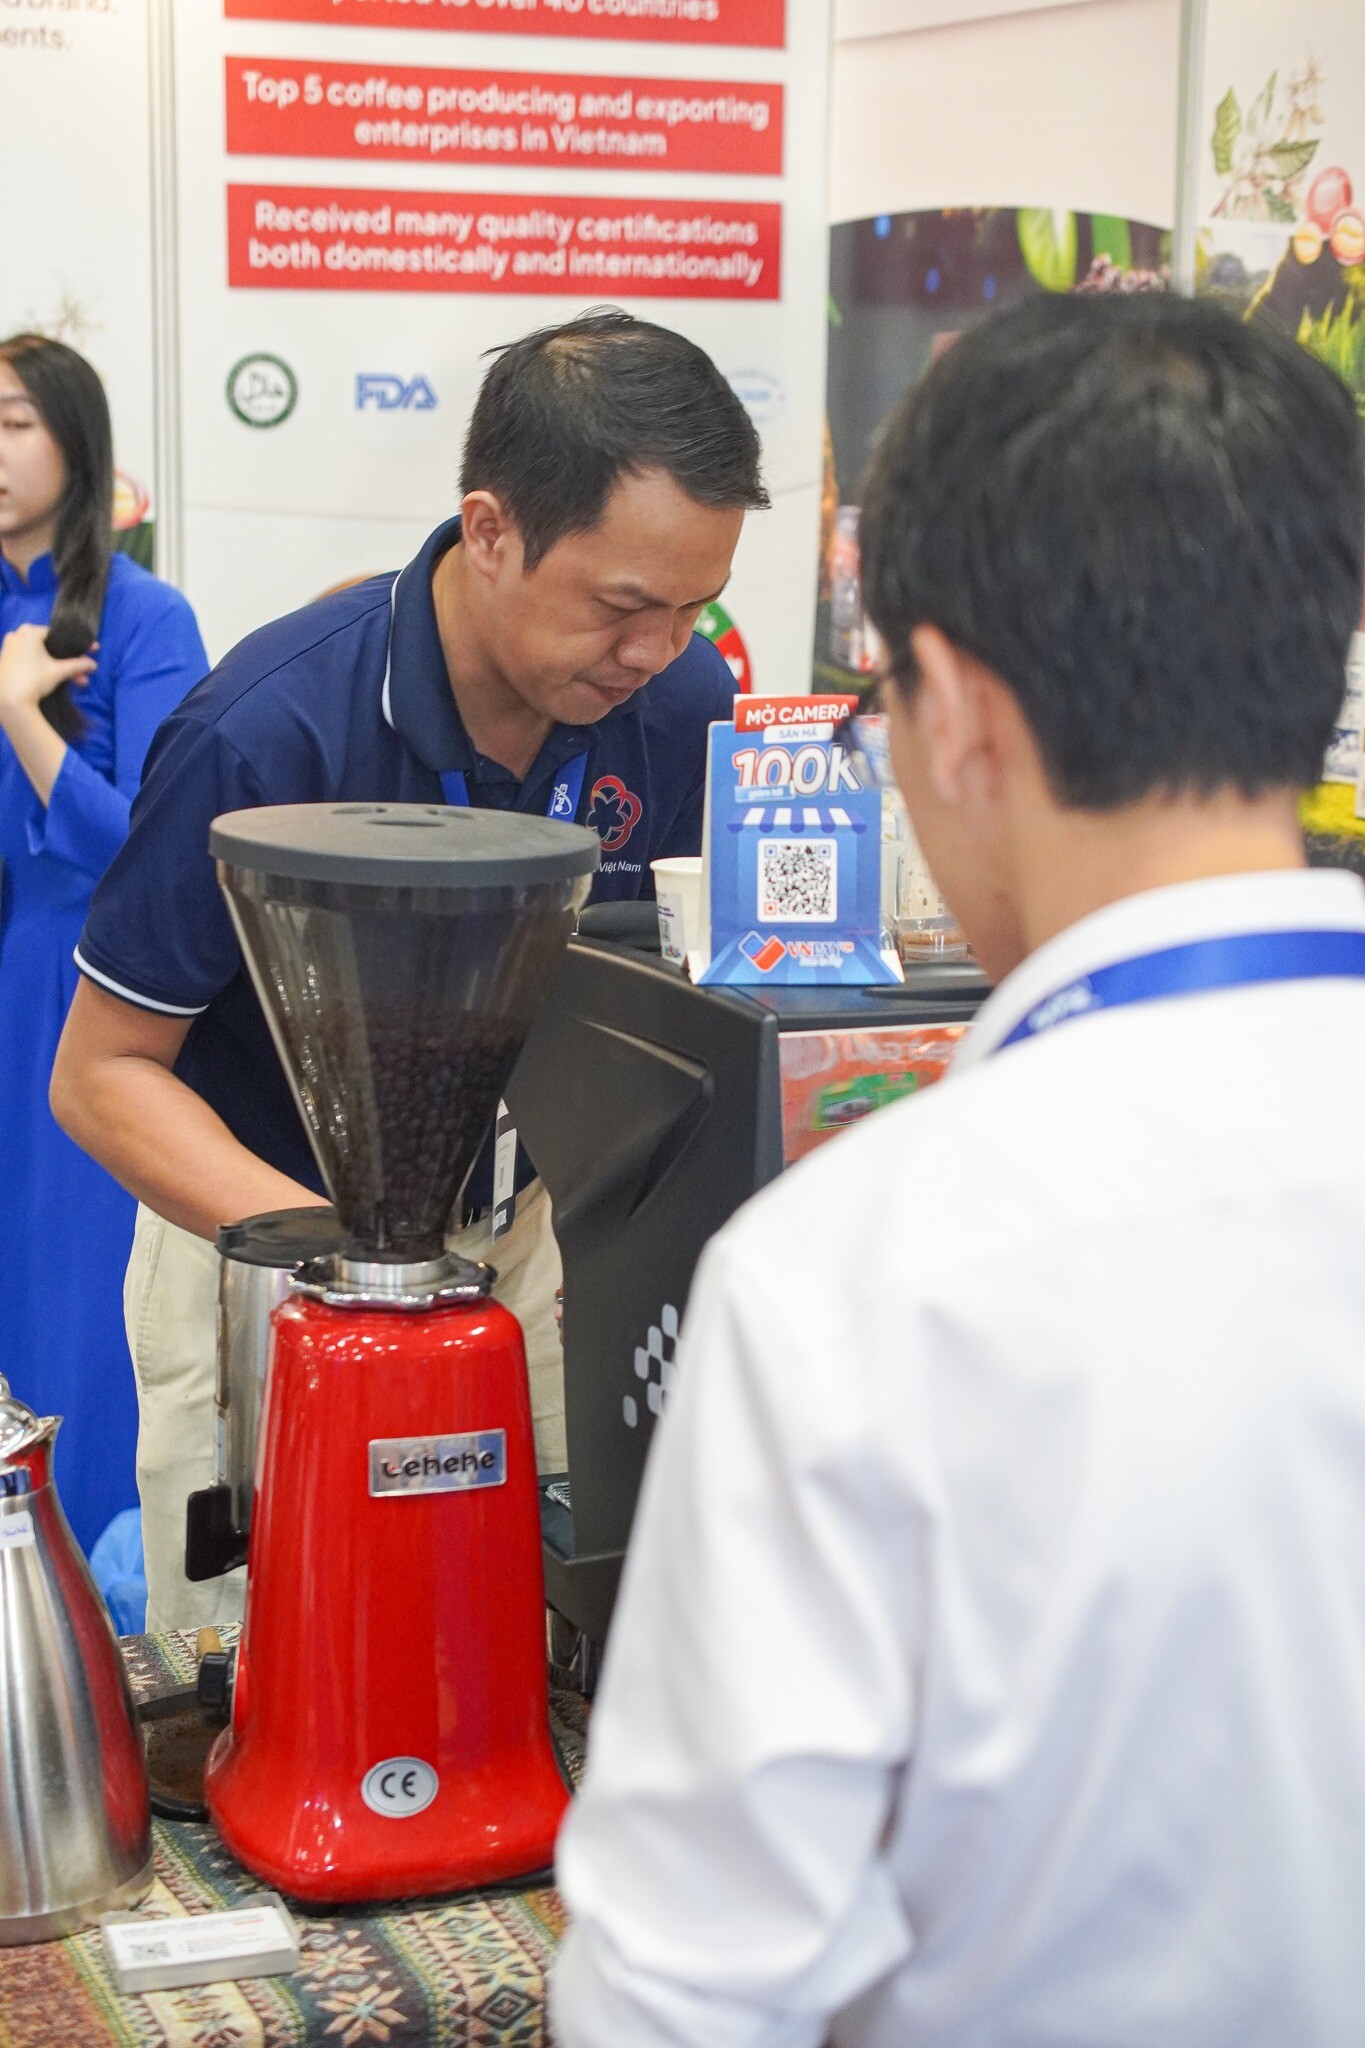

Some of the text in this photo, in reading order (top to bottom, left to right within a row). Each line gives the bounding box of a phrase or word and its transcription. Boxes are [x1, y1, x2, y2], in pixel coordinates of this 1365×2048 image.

[0, 25, 73, 50] ents.
[242, 71, 769, 131] Top 5 coffee producing and exporting
[354, 119, 667, 156] enterprises in Vietnam
[255, 200, 759, 247] Received many quality certifications
[249, 238, 764, 287] both domestically and internationally
[355, 373, 438, 411] FDA
[745, 703, 850, 726] MỞ CAMERA
[600, 861, 641, 874] Việt Nam
